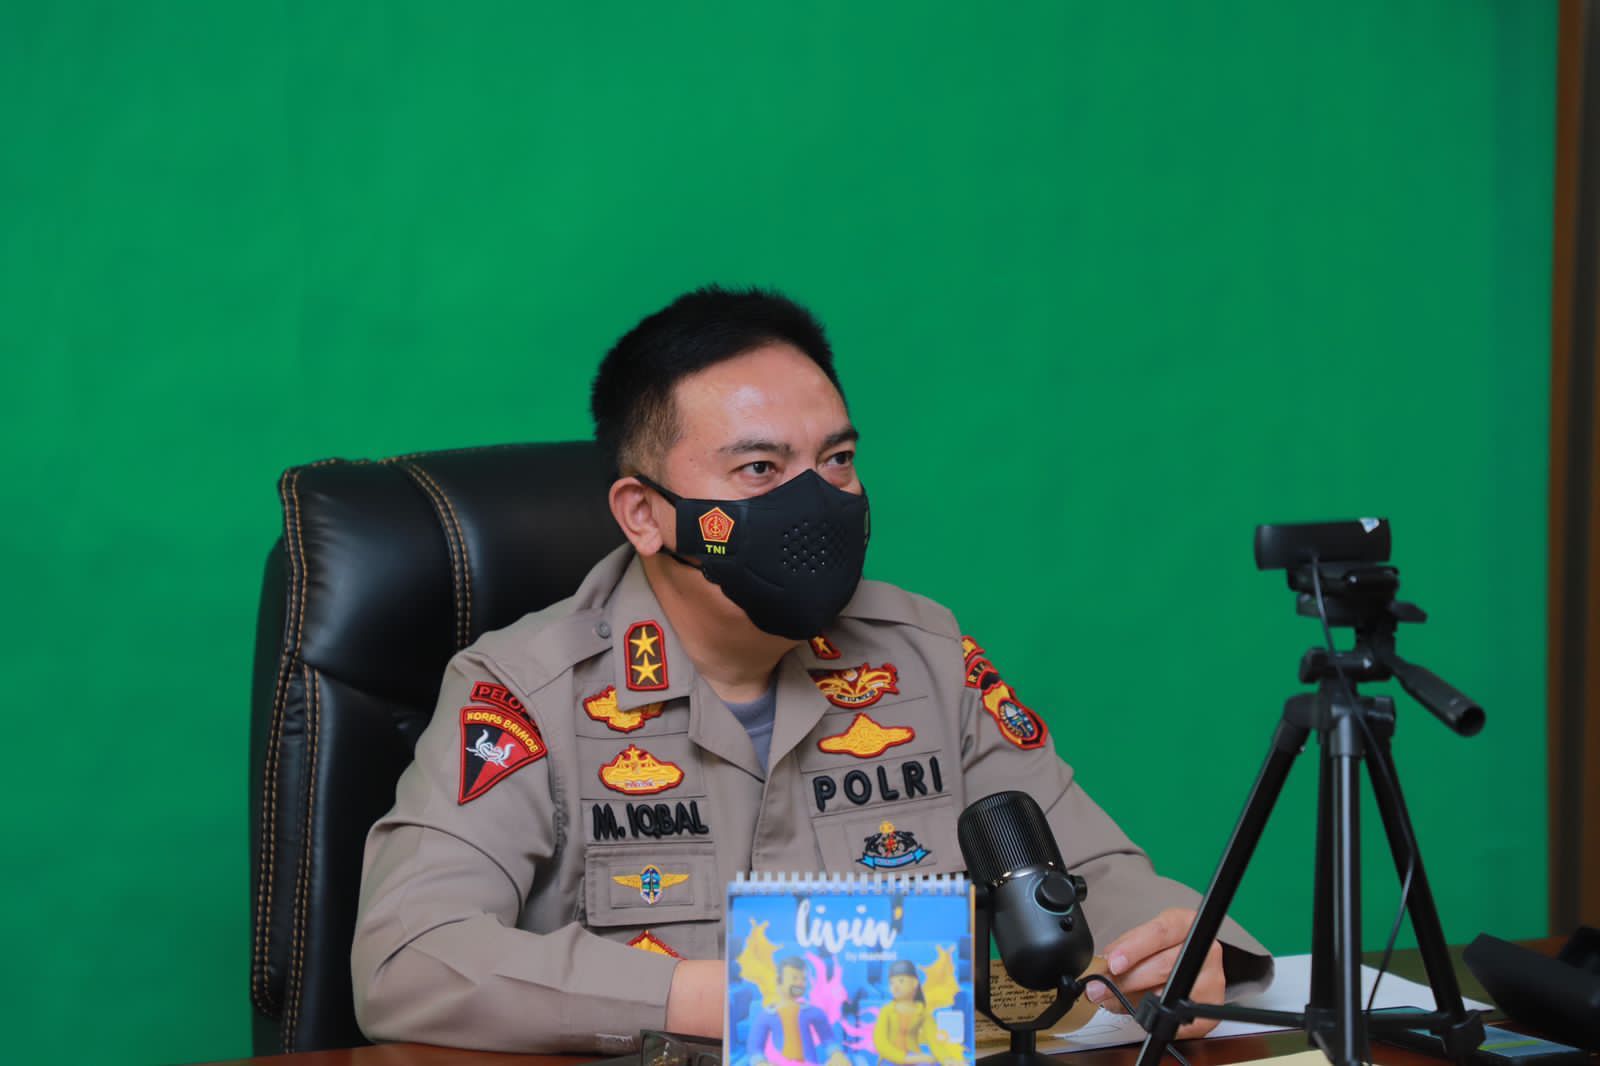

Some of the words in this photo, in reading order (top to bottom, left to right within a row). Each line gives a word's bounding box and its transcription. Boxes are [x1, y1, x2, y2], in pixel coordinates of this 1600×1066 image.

[705, 544, 726, 555] TNI
[466, 711, 503, 725] KORPS
[502, 719, 538, 753] BRIMOB
[813, 756, 943, 813] POLRI
[592, 803, 626, 840] M.
[626, 800, 710, 839] IQBAL
